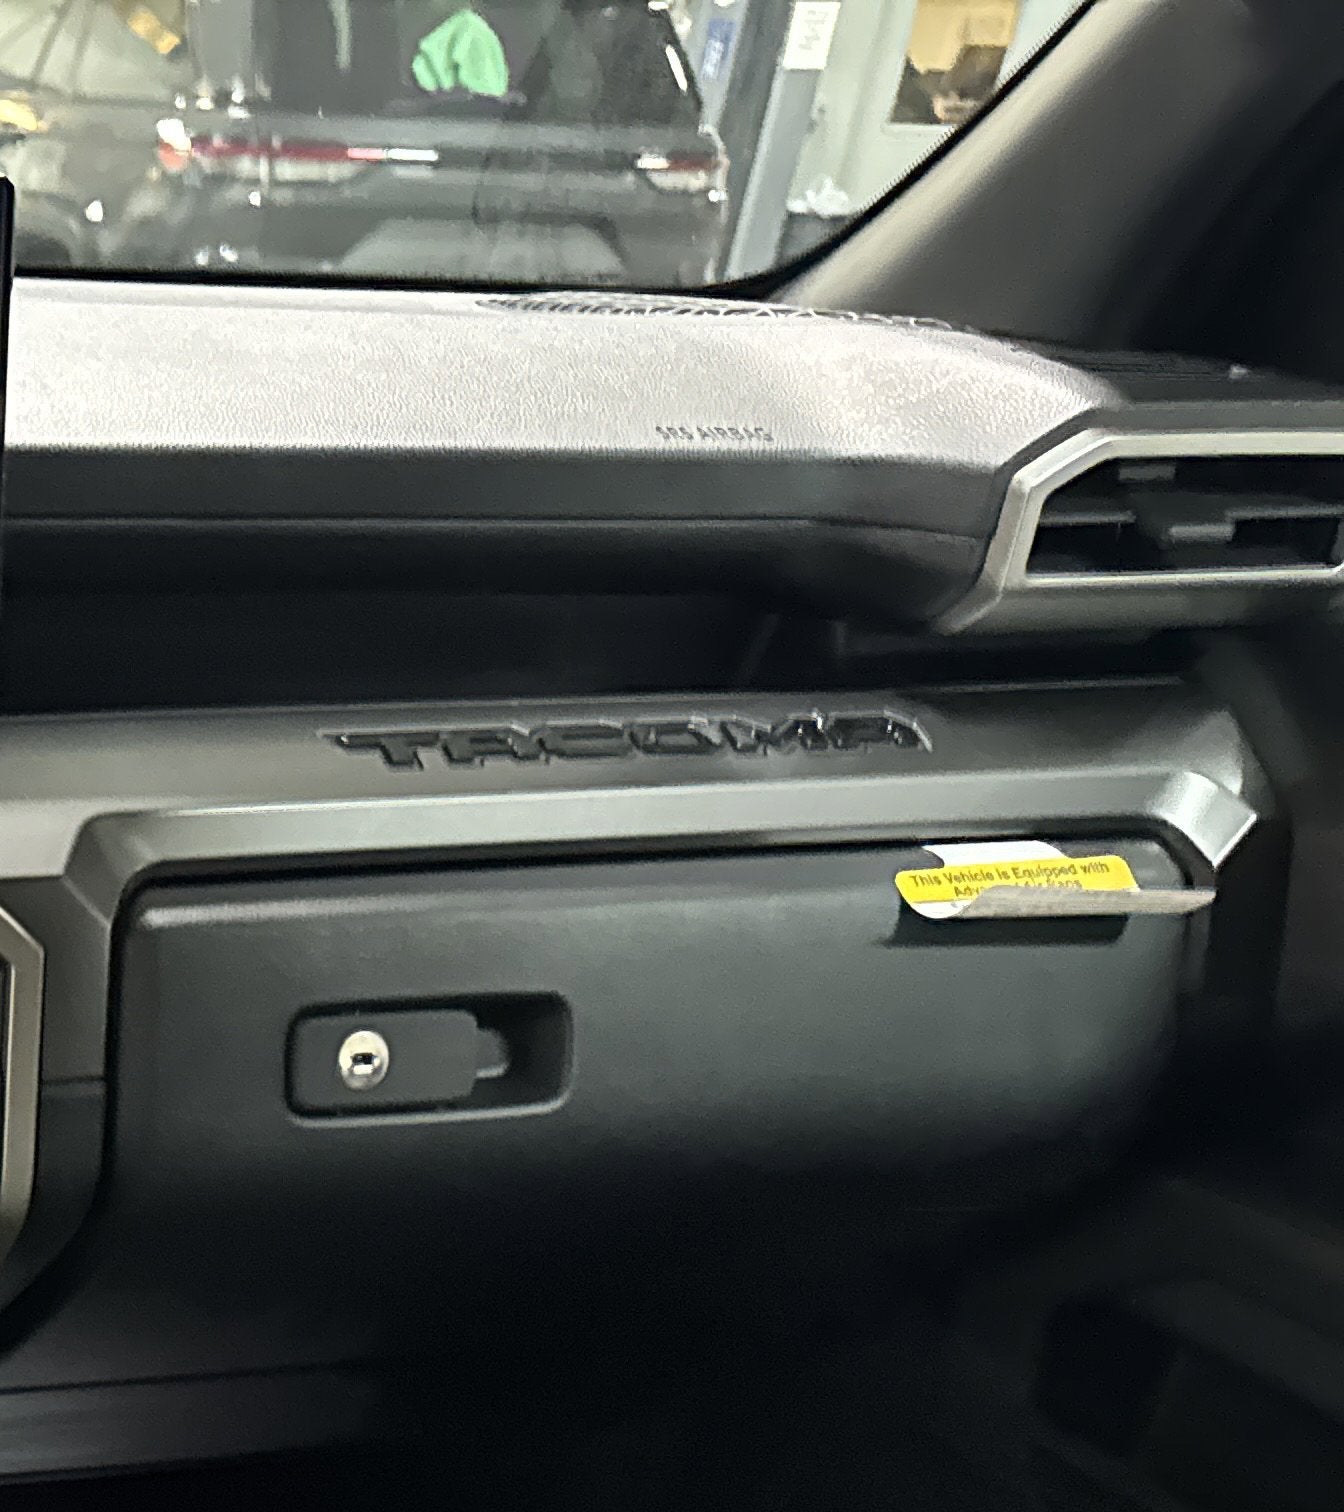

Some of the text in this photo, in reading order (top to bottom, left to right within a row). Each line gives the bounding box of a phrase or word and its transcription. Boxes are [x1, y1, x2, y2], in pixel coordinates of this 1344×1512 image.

[909, 872, 941, 889] This
[943, 868, 995, 886] Vehicle
[1012, 863, 1077, 881] Equipped
[1080, 861, 1110, 875] with
